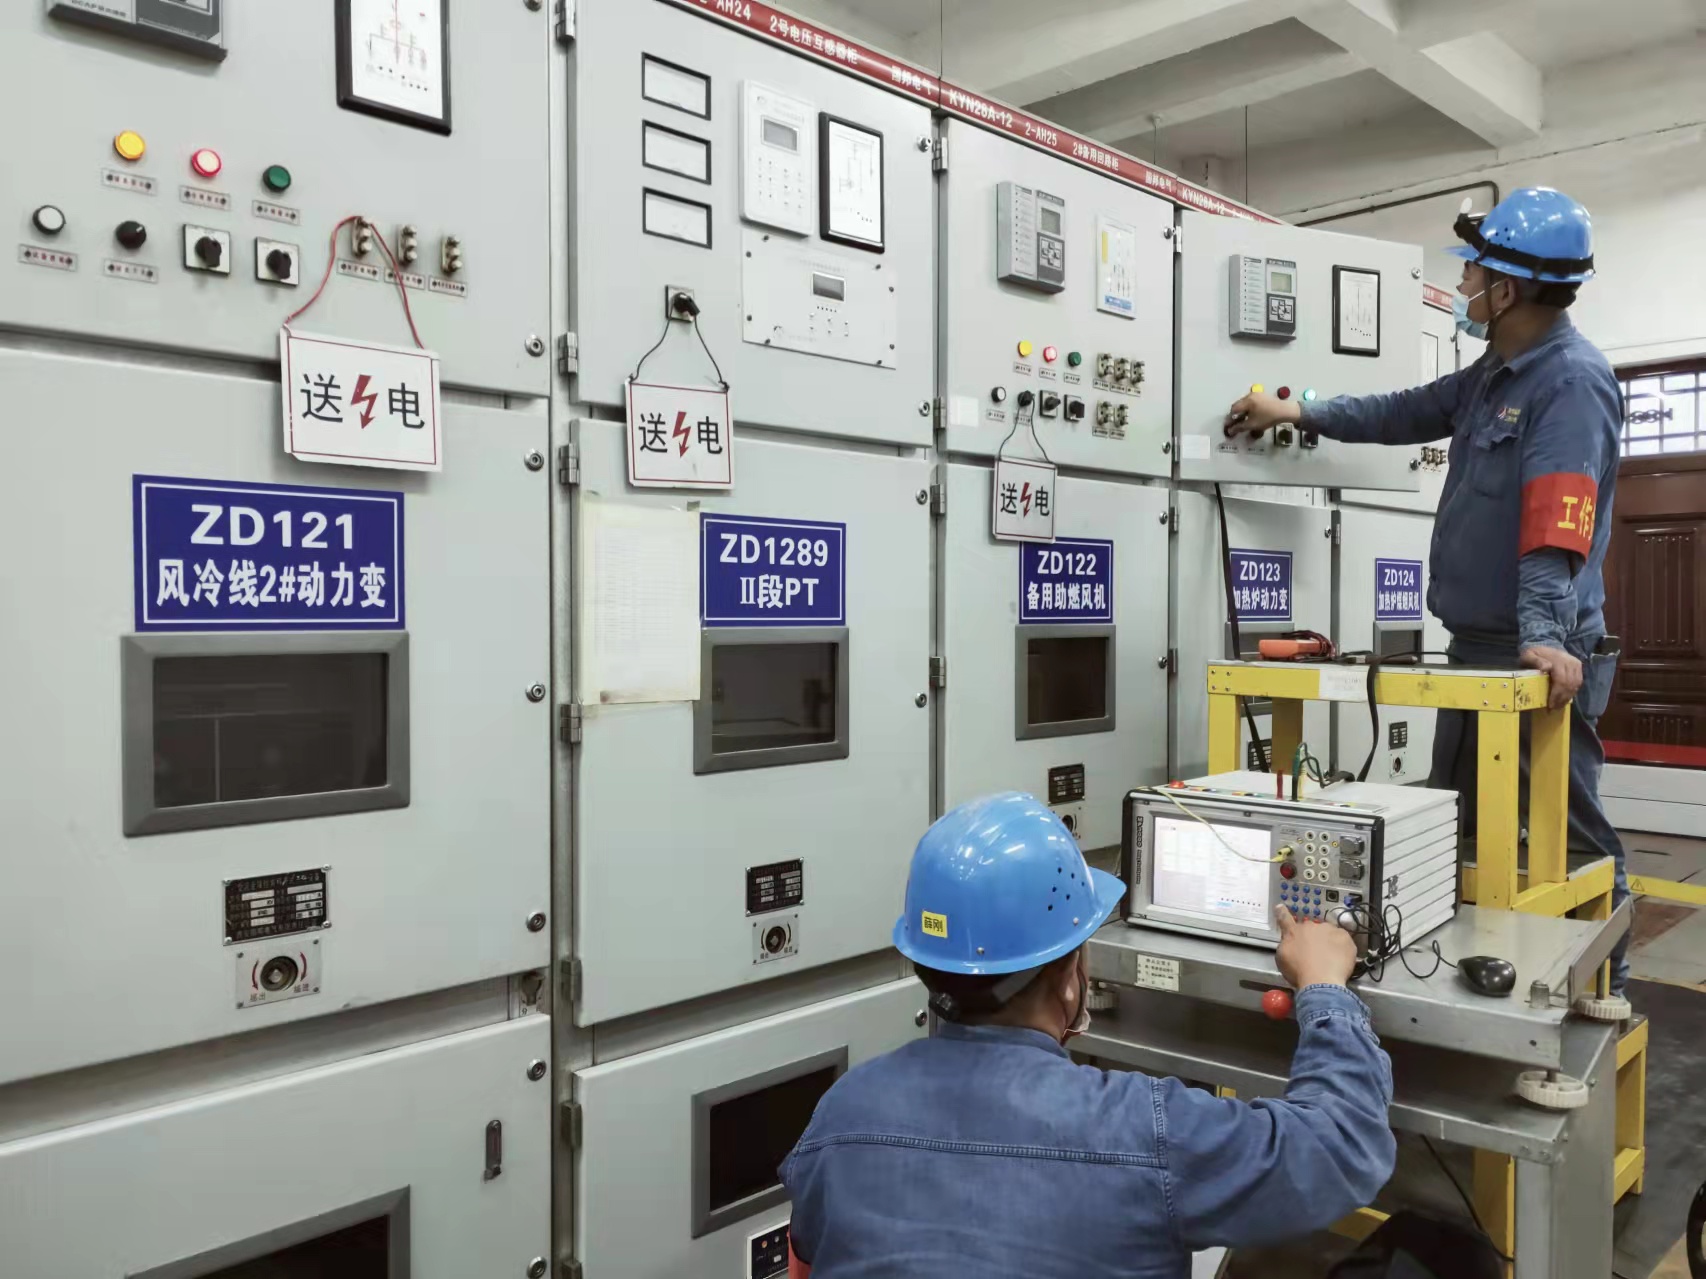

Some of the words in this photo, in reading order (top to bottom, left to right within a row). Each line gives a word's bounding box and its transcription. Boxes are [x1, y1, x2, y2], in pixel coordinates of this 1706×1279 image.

[1025, 122, 1058, 147] 2-AH25
[301, 373, 344, 423] 送
[388, 382, 426, 430] 电
[638, 413, 668, 455] 送
[696, 416, 723, 456] 电
[1000, 483, 1017, 515] 送
[1035, 486, 1050, 517] 电
[190, 503, 355, 550] ZD121
[1557, 495, 1597, 541] 工作
[719, 533, 829, 568] ZD1289
[1037, 550, 1097, 577] ZD122
[156, 558, 387, 609] 风冷线2#动力变
[1239, 560, 1281, 582] ZD123
[1384, 568, 1415, 587] ZD124
[1026, 582, 1107, 611] 备用助燃风机
[1232, 586, 1288, 611] 加热炉动力变
